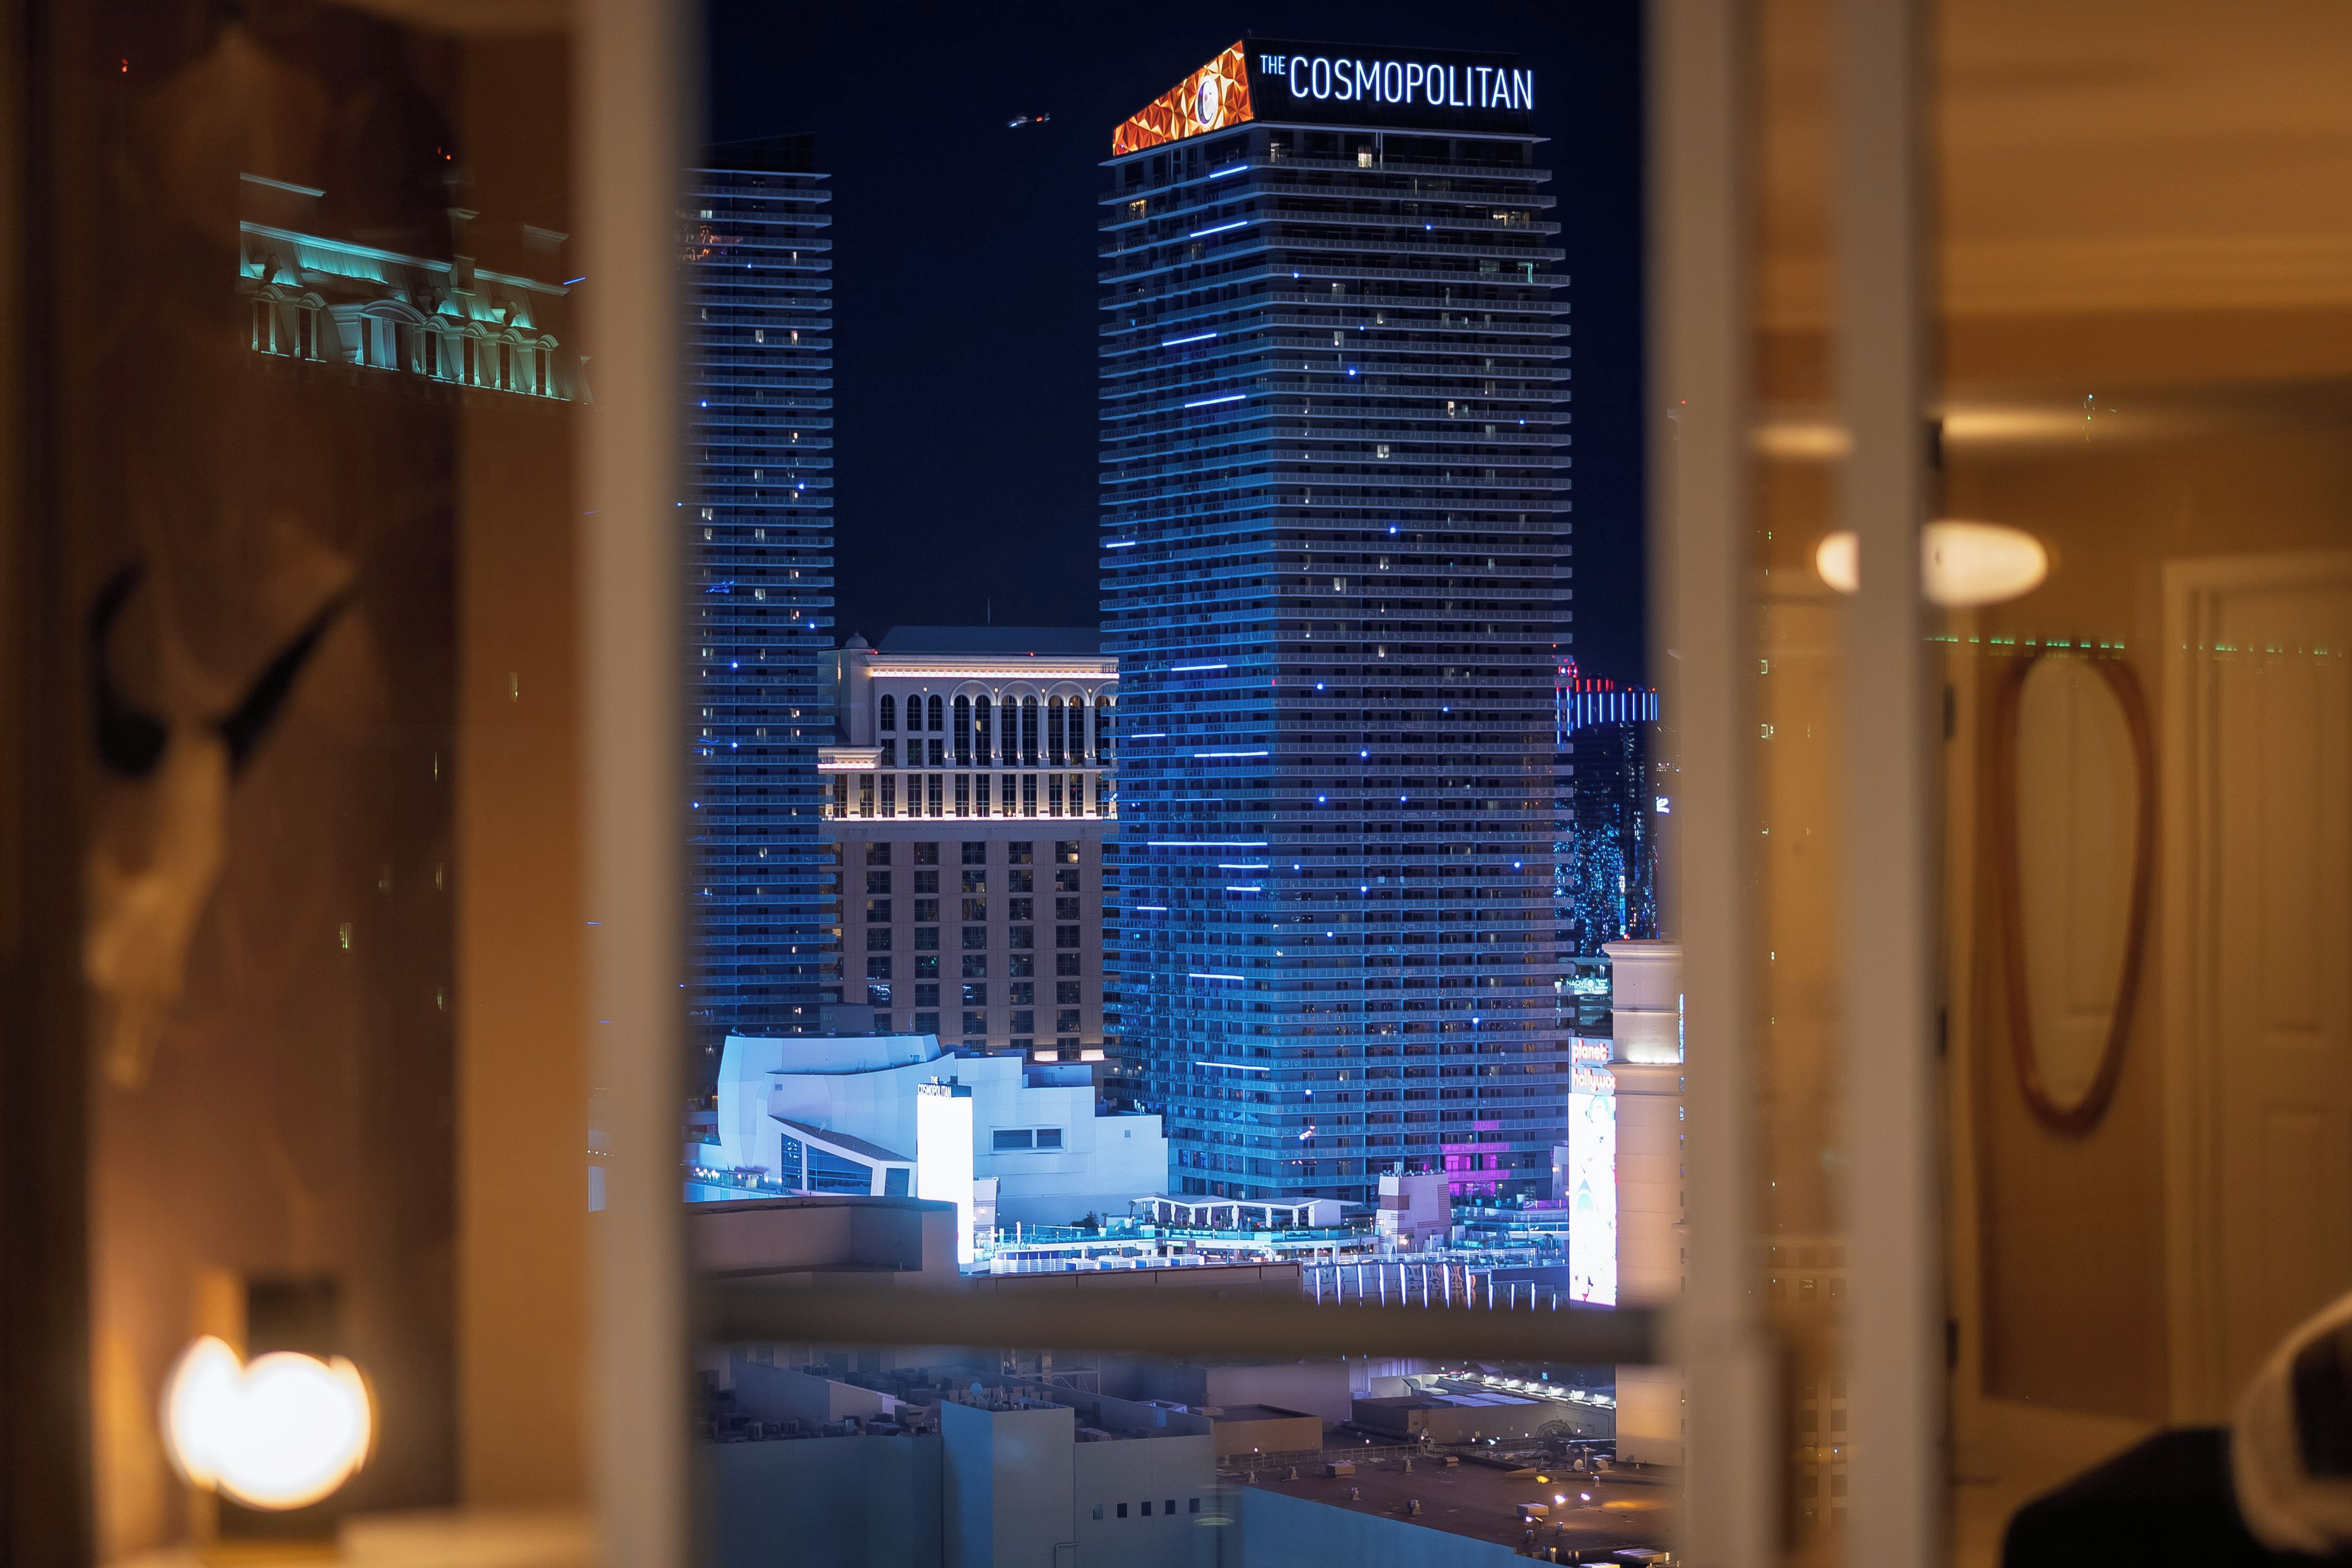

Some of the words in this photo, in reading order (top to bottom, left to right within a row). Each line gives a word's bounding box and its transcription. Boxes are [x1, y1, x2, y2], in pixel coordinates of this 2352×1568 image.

[1260, 55, 1286, 75] THE
[1291, 56, 1532, 110] COSMOPOLITAN
[1572, 1039, 1608, 1063] planet
[918, 1083, 951, 1096] COSMOPOLITAN
